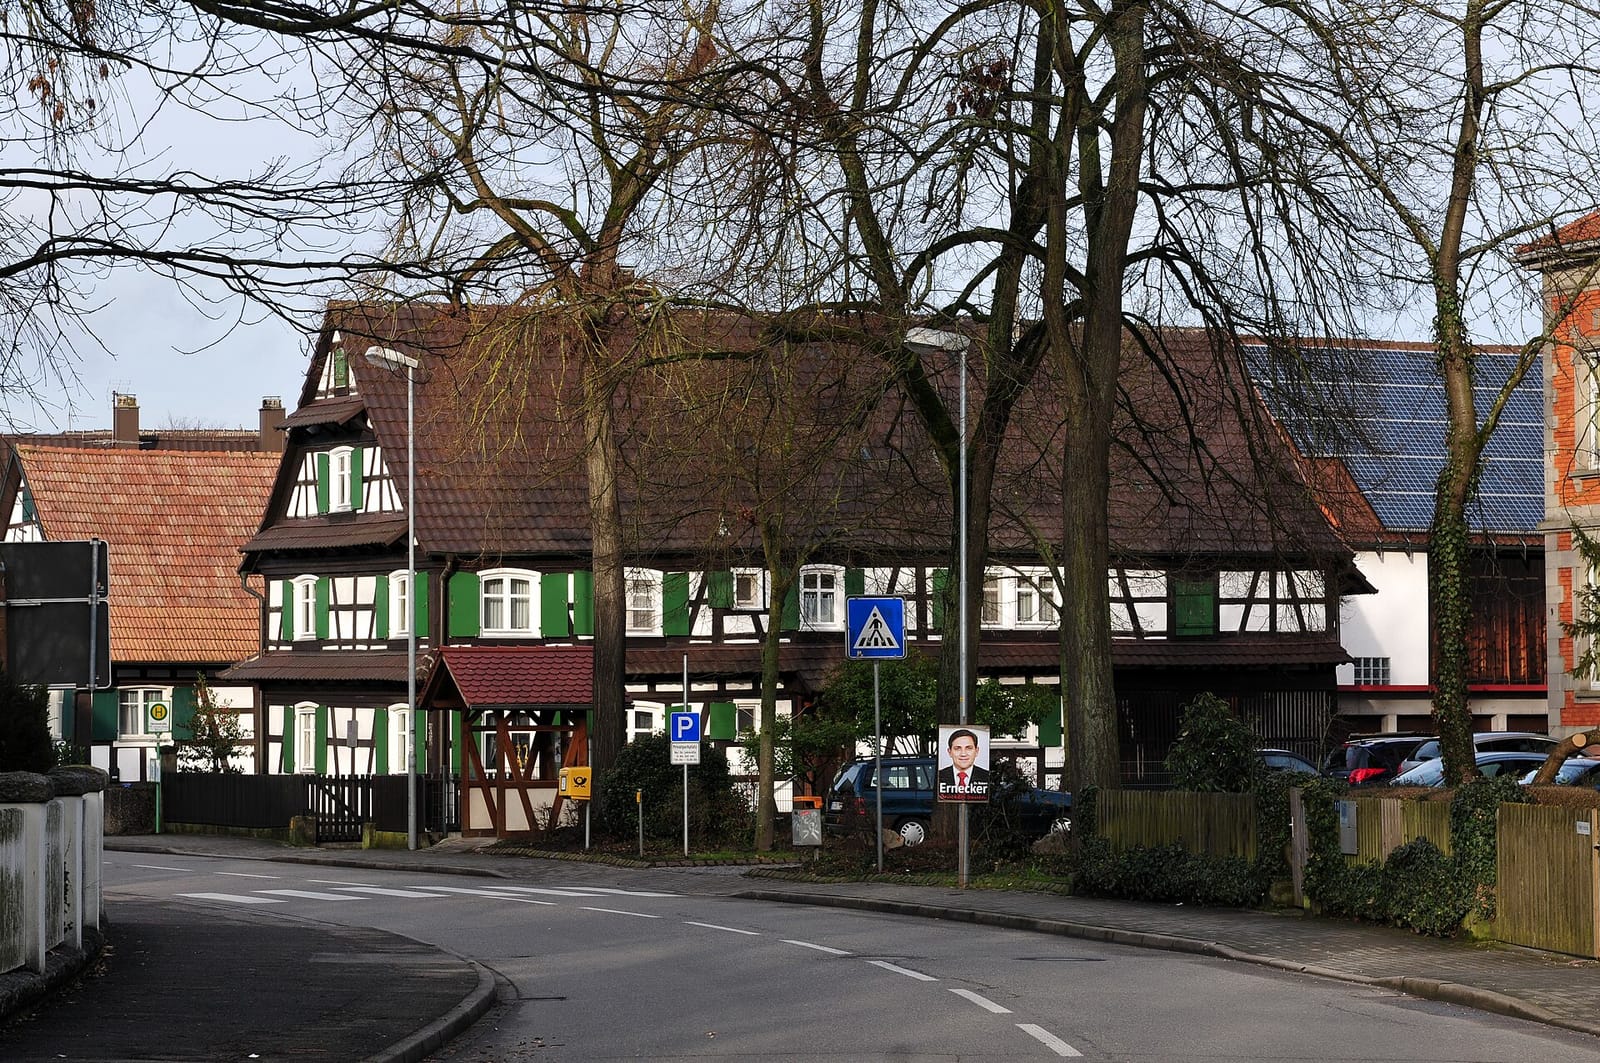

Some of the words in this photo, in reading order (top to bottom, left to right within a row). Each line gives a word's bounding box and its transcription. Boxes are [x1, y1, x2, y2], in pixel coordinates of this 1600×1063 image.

[155, 707, 163, 717] H
[677, 716, 693, 739] P
[939, 781, 988, 794] Ernecker
